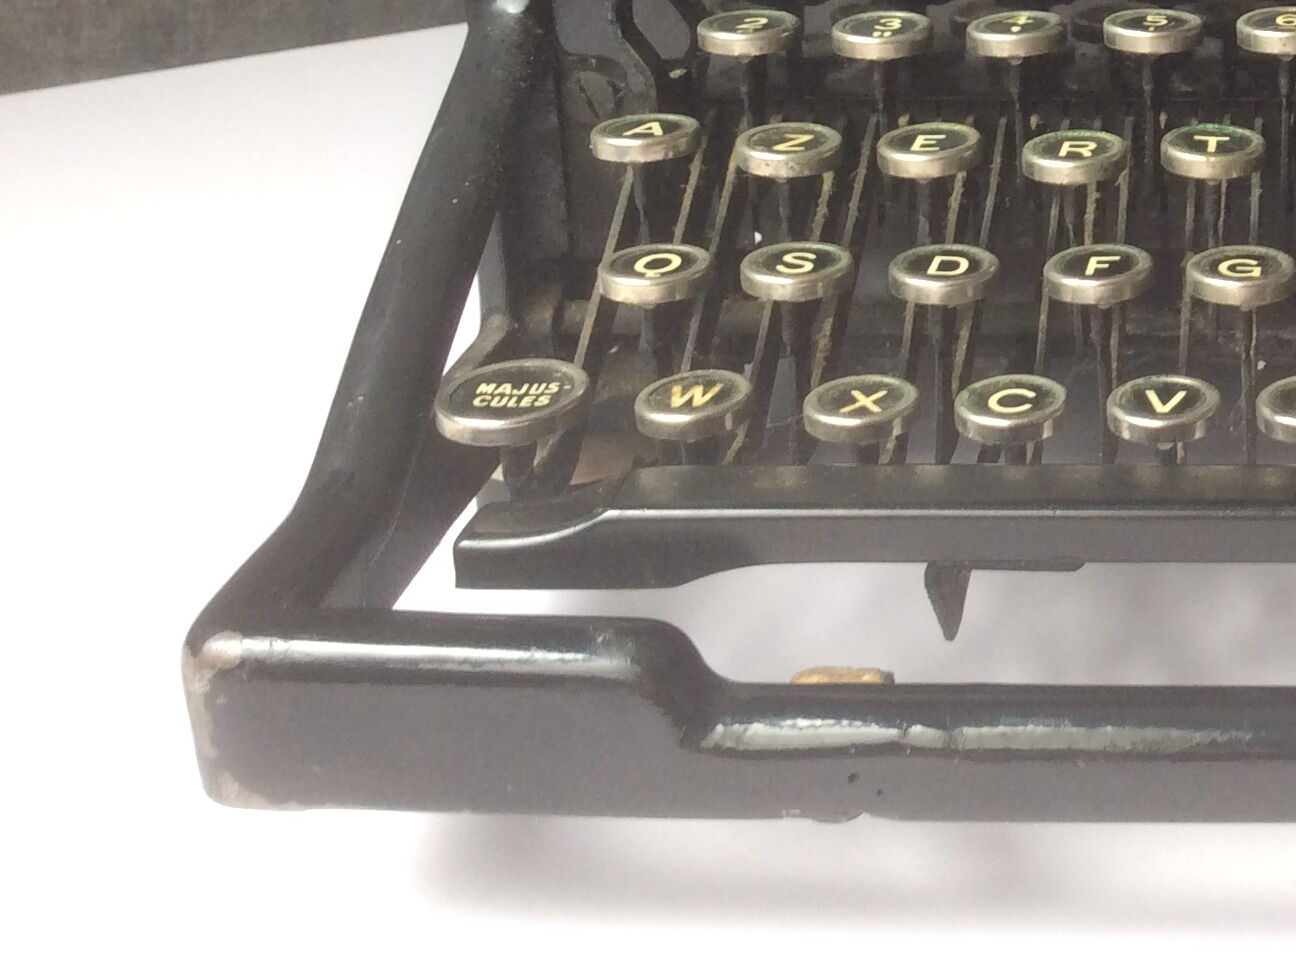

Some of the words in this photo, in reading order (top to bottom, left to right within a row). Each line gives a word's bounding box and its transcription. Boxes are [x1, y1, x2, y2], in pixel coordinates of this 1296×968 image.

[735, 17, 769, 29] 2
[873, 18, 903, 30] 3
[1143, 15, 1168, 27] 5
[622, 121, 664, 136] A
[772, 134, 815, 151] Z
[910, 134, 947, 152] E
[1058, 140, 1098, 158] R
[1193, 135, 1230, 153] T
[633, 252, 683, 278] Q
[774, 251, 817, 275] S
[926, 255, 970, 277] D
[1084, 255, 1121, 277] F
[1217, 258, 1261, 278] G
[475, 382, 572, 396] MAJUS-
[669, 383, 725, 408] W
[472, 394, 552, 408] CULES
[838, 389, 888, 413] X
[987, 388, 1037, 414] C
[1144, 389, 1187, 414] V
